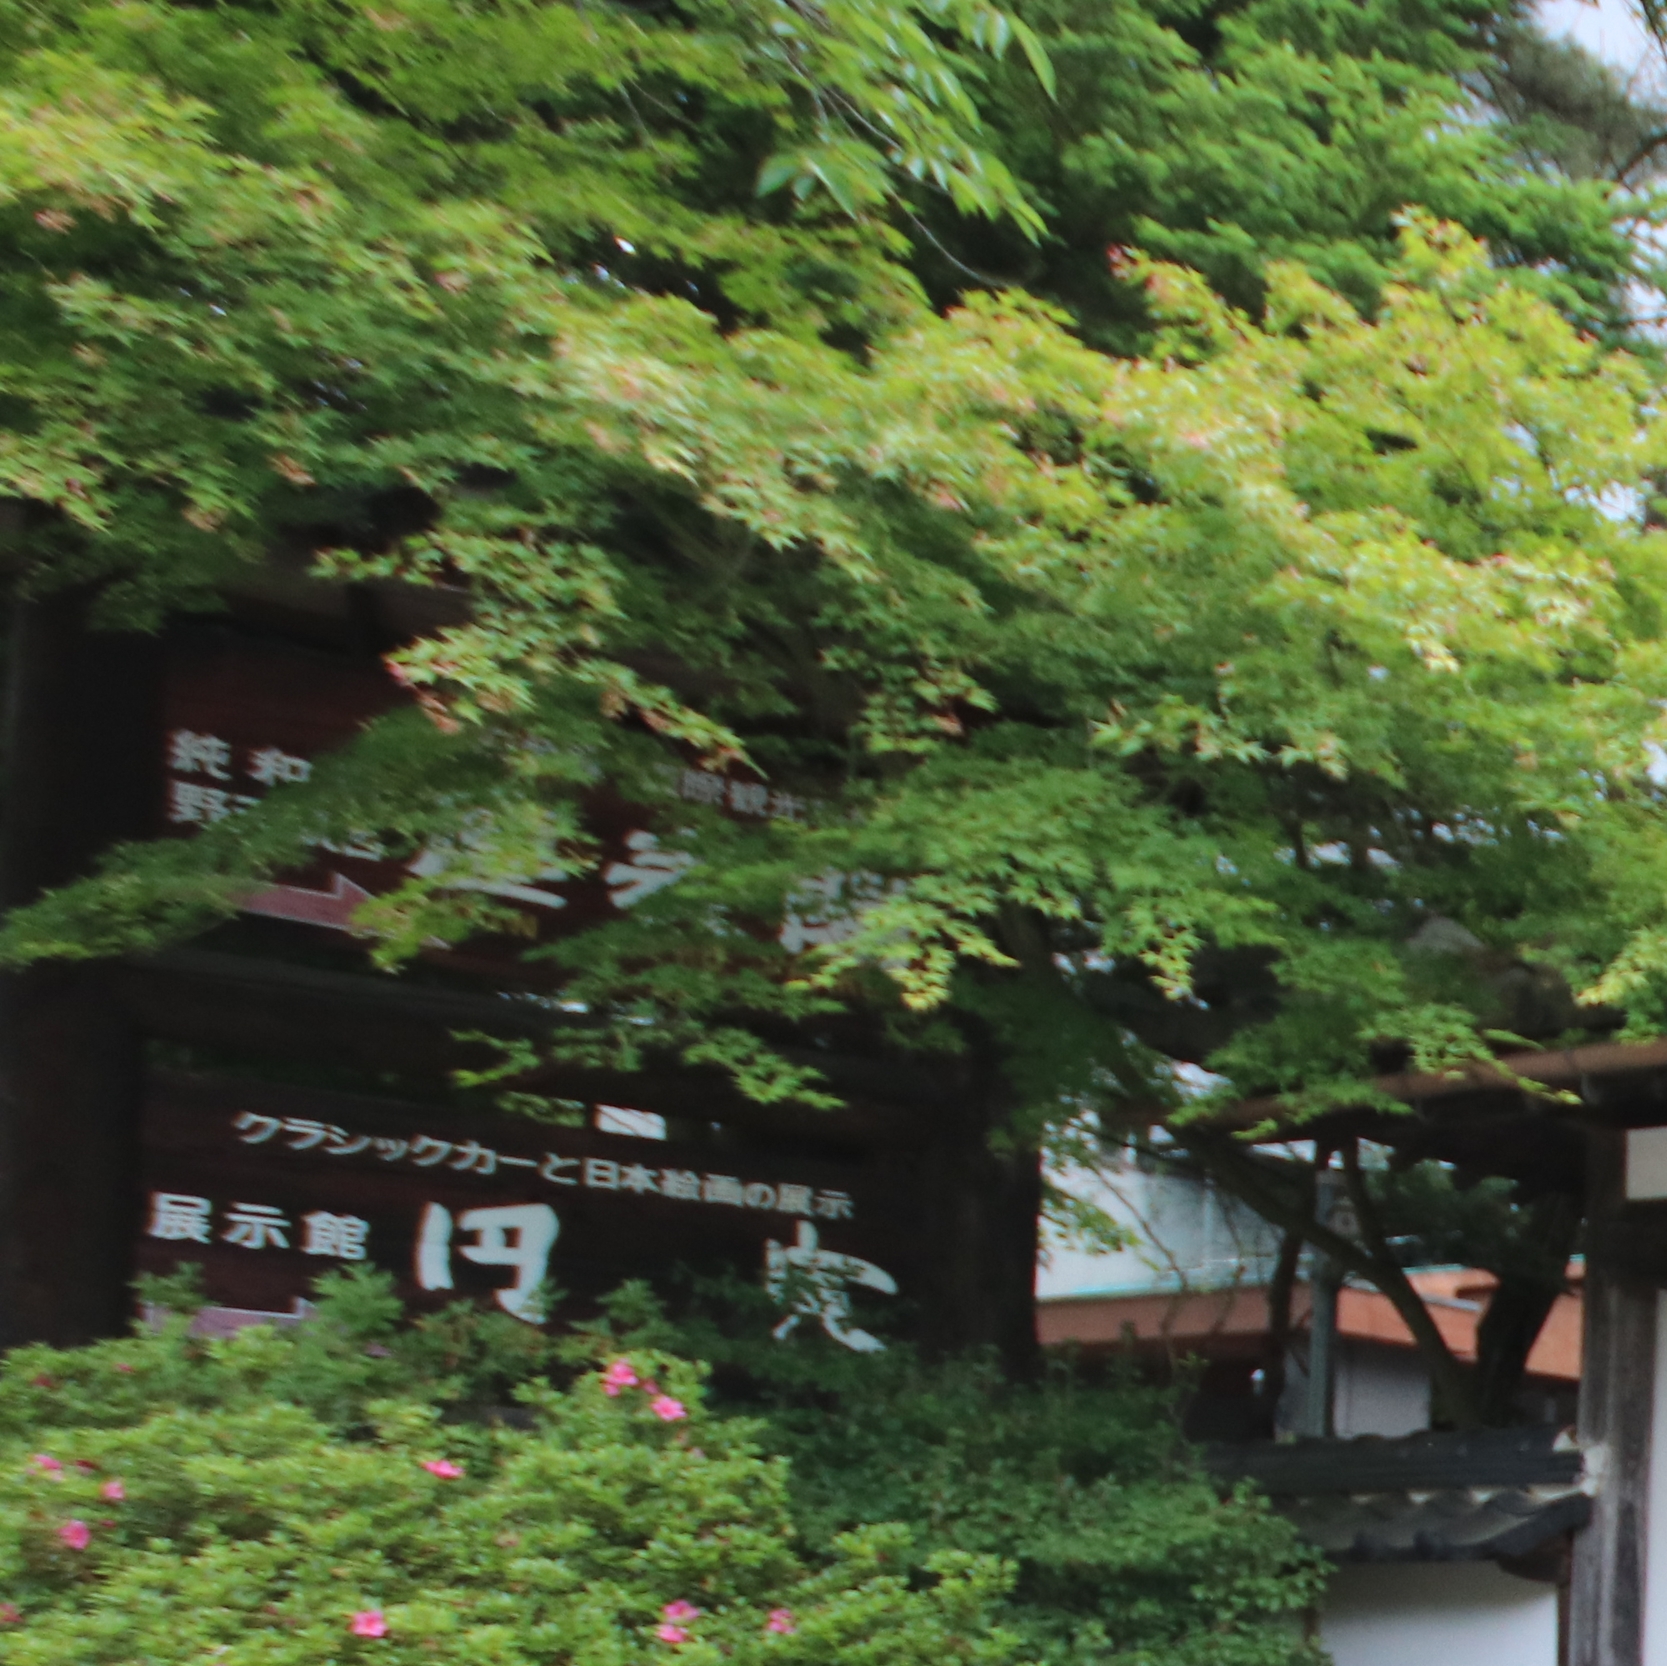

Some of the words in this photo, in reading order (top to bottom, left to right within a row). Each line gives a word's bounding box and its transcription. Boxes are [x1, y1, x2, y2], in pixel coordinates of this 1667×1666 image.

[231, 1110, 855, 1219] クラシックカーと日本絵画の展示
[146, 1190, 371, 1261] 展示館
